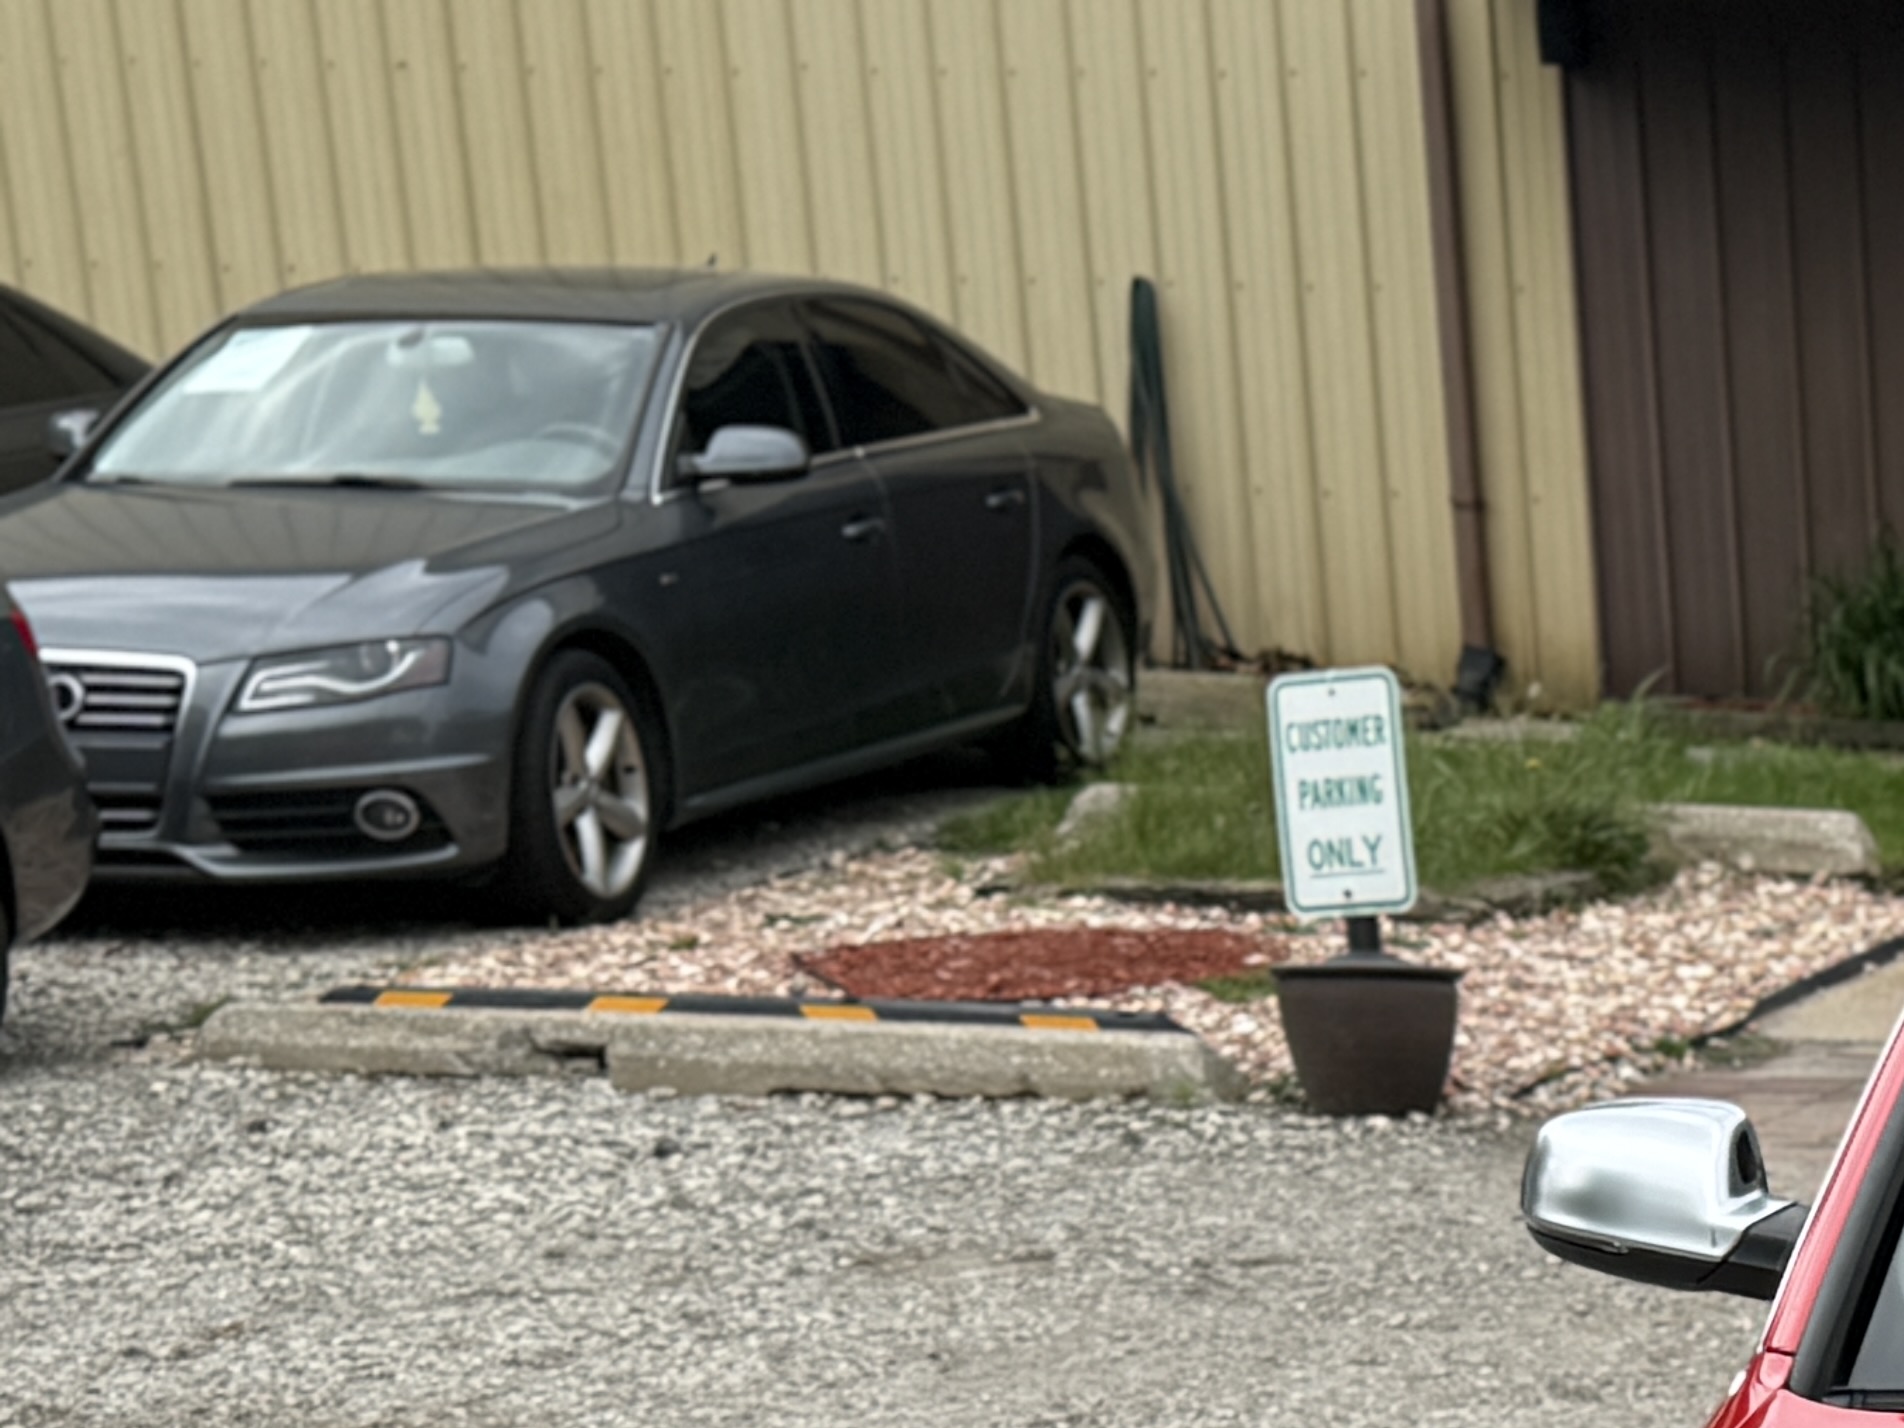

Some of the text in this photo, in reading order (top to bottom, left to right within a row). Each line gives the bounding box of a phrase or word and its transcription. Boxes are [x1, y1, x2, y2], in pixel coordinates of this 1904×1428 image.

[1286, 714, 1386, 753] CUSTOMER
[1298, 773, 1384, 810] PARKING
[1307, 834, 1383, 870] ONLY
